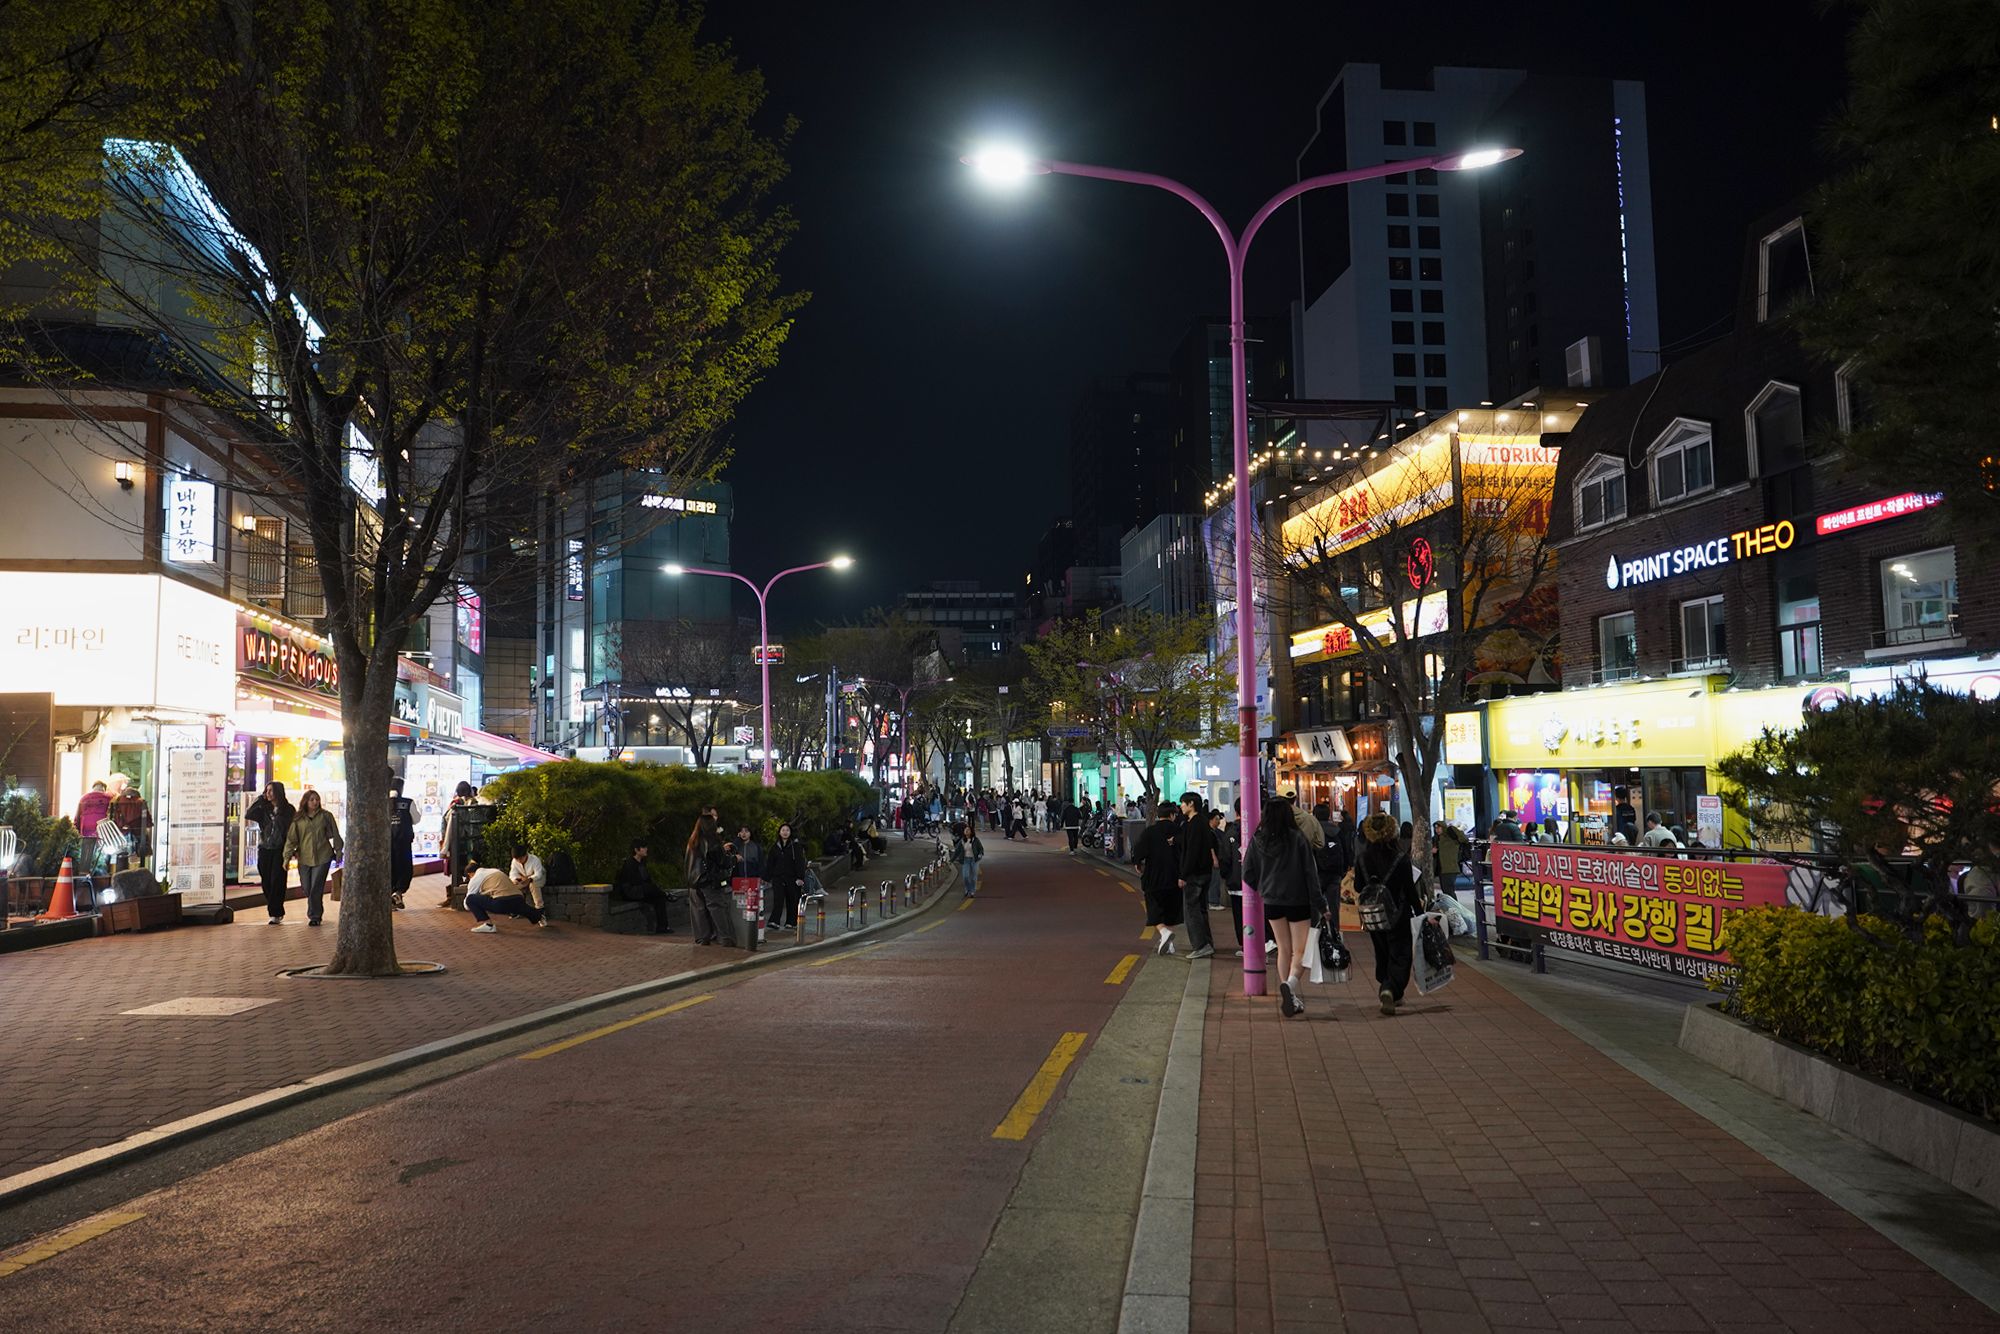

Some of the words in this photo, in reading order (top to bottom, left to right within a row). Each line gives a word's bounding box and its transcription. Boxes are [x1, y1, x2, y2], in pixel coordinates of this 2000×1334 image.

[1621, 551, 1671, 588] PRINT
[1673, 537, 1729, 574] SPACE
[1731, 520, 1795, 560] THEO
[1501, 849, 1540, 876] 상인과
[1545, 855, 1573, 880] 시민
[1577, 857, 1659, 891] 문화예술인
[1663, 865, 1744, 901] 동의없는
[1501, 876, 1563, 924] 전철역
[1569, 887, 1618, 934] 공사
[1622, 894, 1678, 944] 강행
[1550, 931, 1592, 954] 대장홍대선
[1594, 940, 1671, 971] 레드로드역사반대
